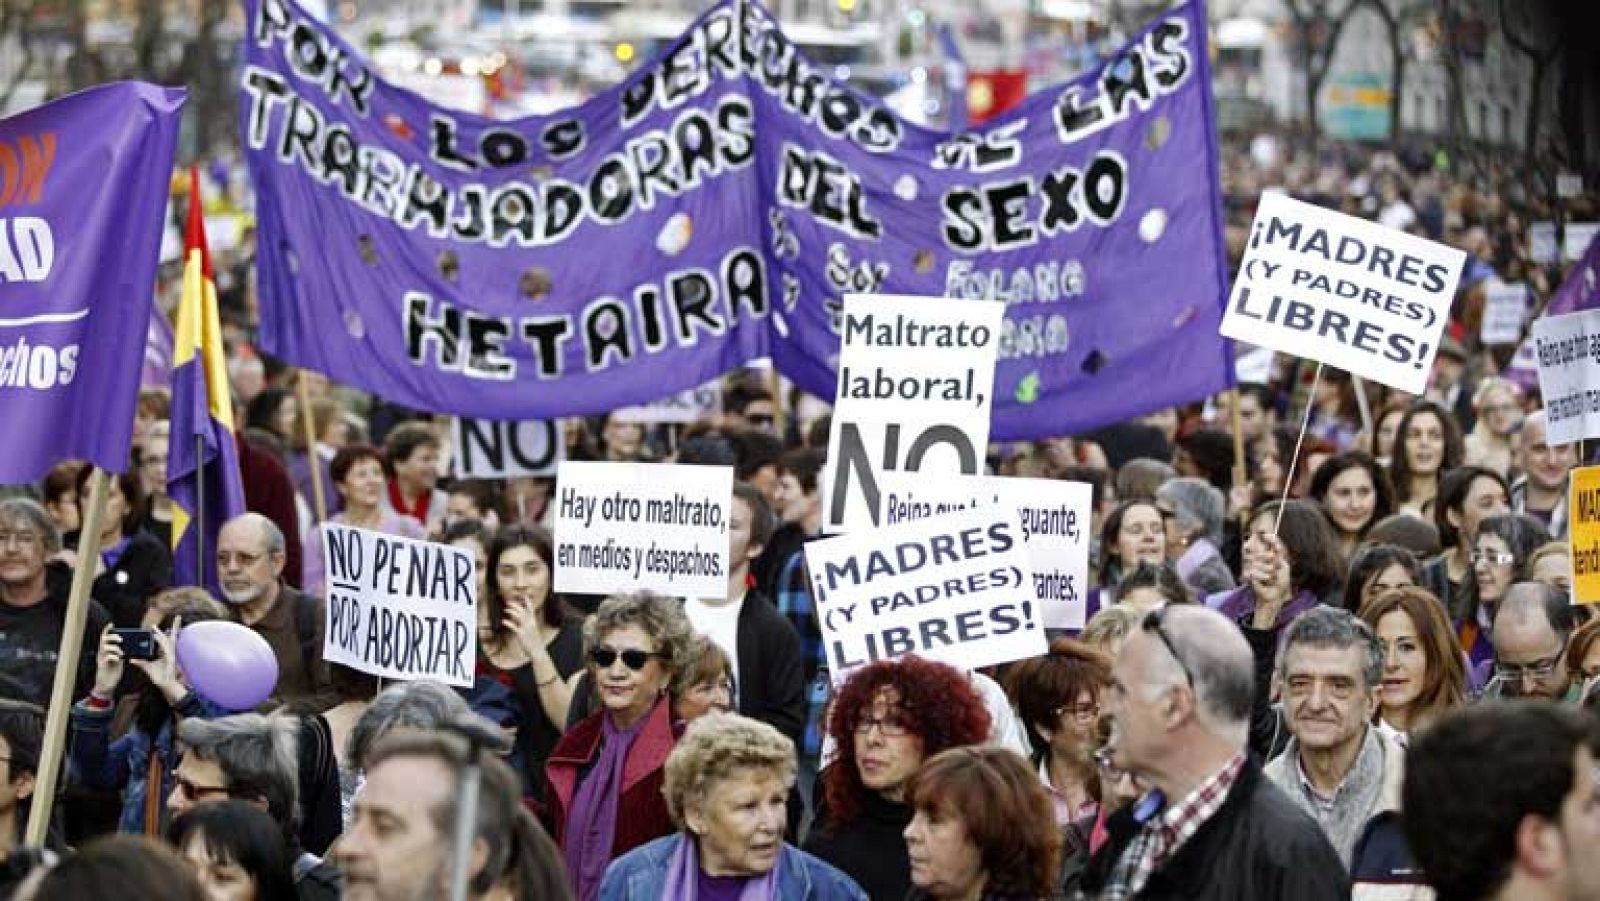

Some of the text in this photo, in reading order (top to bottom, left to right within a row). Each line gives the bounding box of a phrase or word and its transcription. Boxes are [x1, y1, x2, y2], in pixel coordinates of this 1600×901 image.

[255, 0, 373, 118] POR
[430, 113, 588, 169] LOS
[621, 5, 904, 153] DERECHOS
[1053, 17, 1190, 142] LAS
[242, 66, 1127, 251] TRABAJADORAS DEL SEXO
[1251, 216, 1449, 293] ¡MADRES
[403, 247, 771, 379] HETAIRA
[1245, 258, 1436, 328] (Y PADRES)
[845, 314, 991, 347] Maltrato
[1235, 287, 1430, 370] LIBRES!
[841, 366, 985, 408] laboral,
[460, 416, 556, 473] NO
[828, 421, 978, 527] NO
[559, 487, 727, 535] Hay otro maltrato,
[1018, 504, 1080, 544] guante,
[327, 528, 474, 605] NO PENAR
[557, 537, 724, 582] en medios y despachos.
[814, 522, 1014, 602] ¡MADRES
[330, 593, 361, 659] POR
[826, 566, 1024, 632] (Y PADRES)
[833, 600, 1035, 670] LIBRES!
